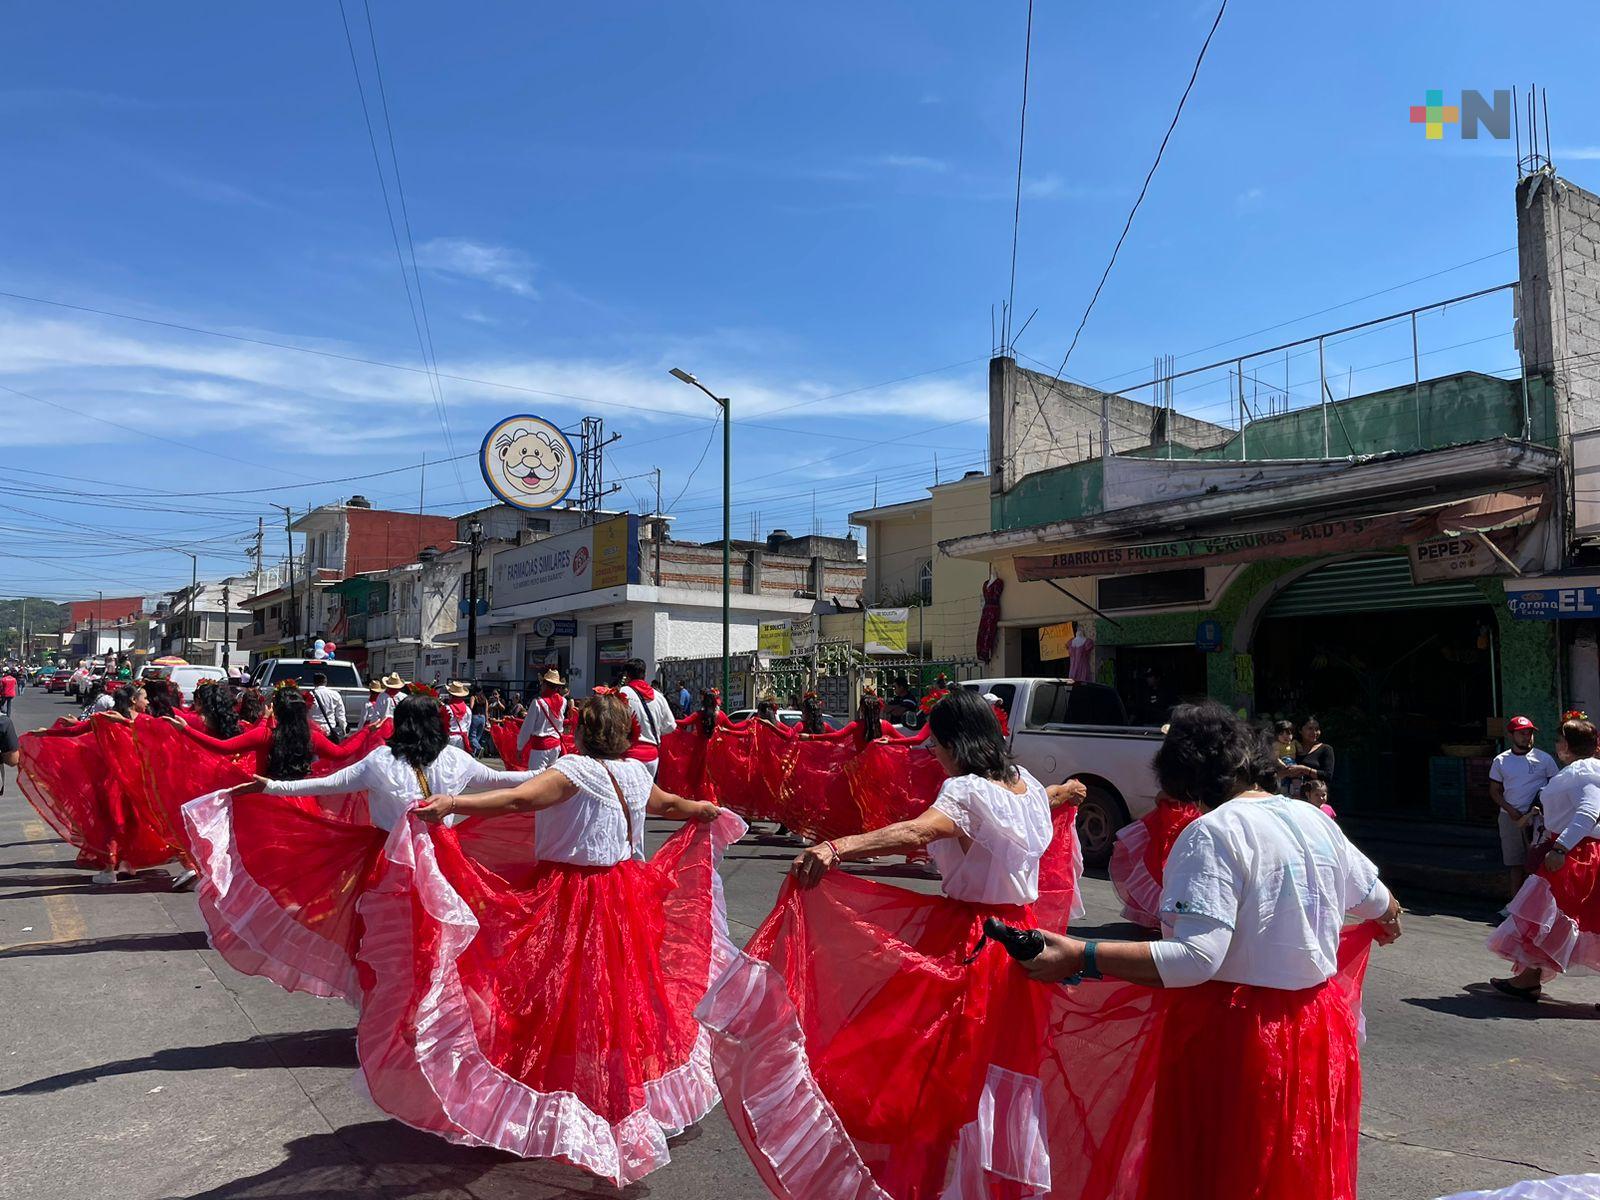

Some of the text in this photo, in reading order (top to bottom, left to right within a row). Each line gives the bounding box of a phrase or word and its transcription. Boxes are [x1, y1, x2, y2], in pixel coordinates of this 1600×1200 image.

[1052, 548, 1122, 567] ABARROTES
[1128, 543, 1178, 560] FRUTAS
[1186, 543, 1195, 555] Y
[1417, 541, 1460, 560] PEPE
[507, 557, 538, 581] FARMACIAS
[538, 550, 571, 574] SIMILARES
[1507, 599, 1558, 613] Corona
[1558, 589, 1594, 612] EL
